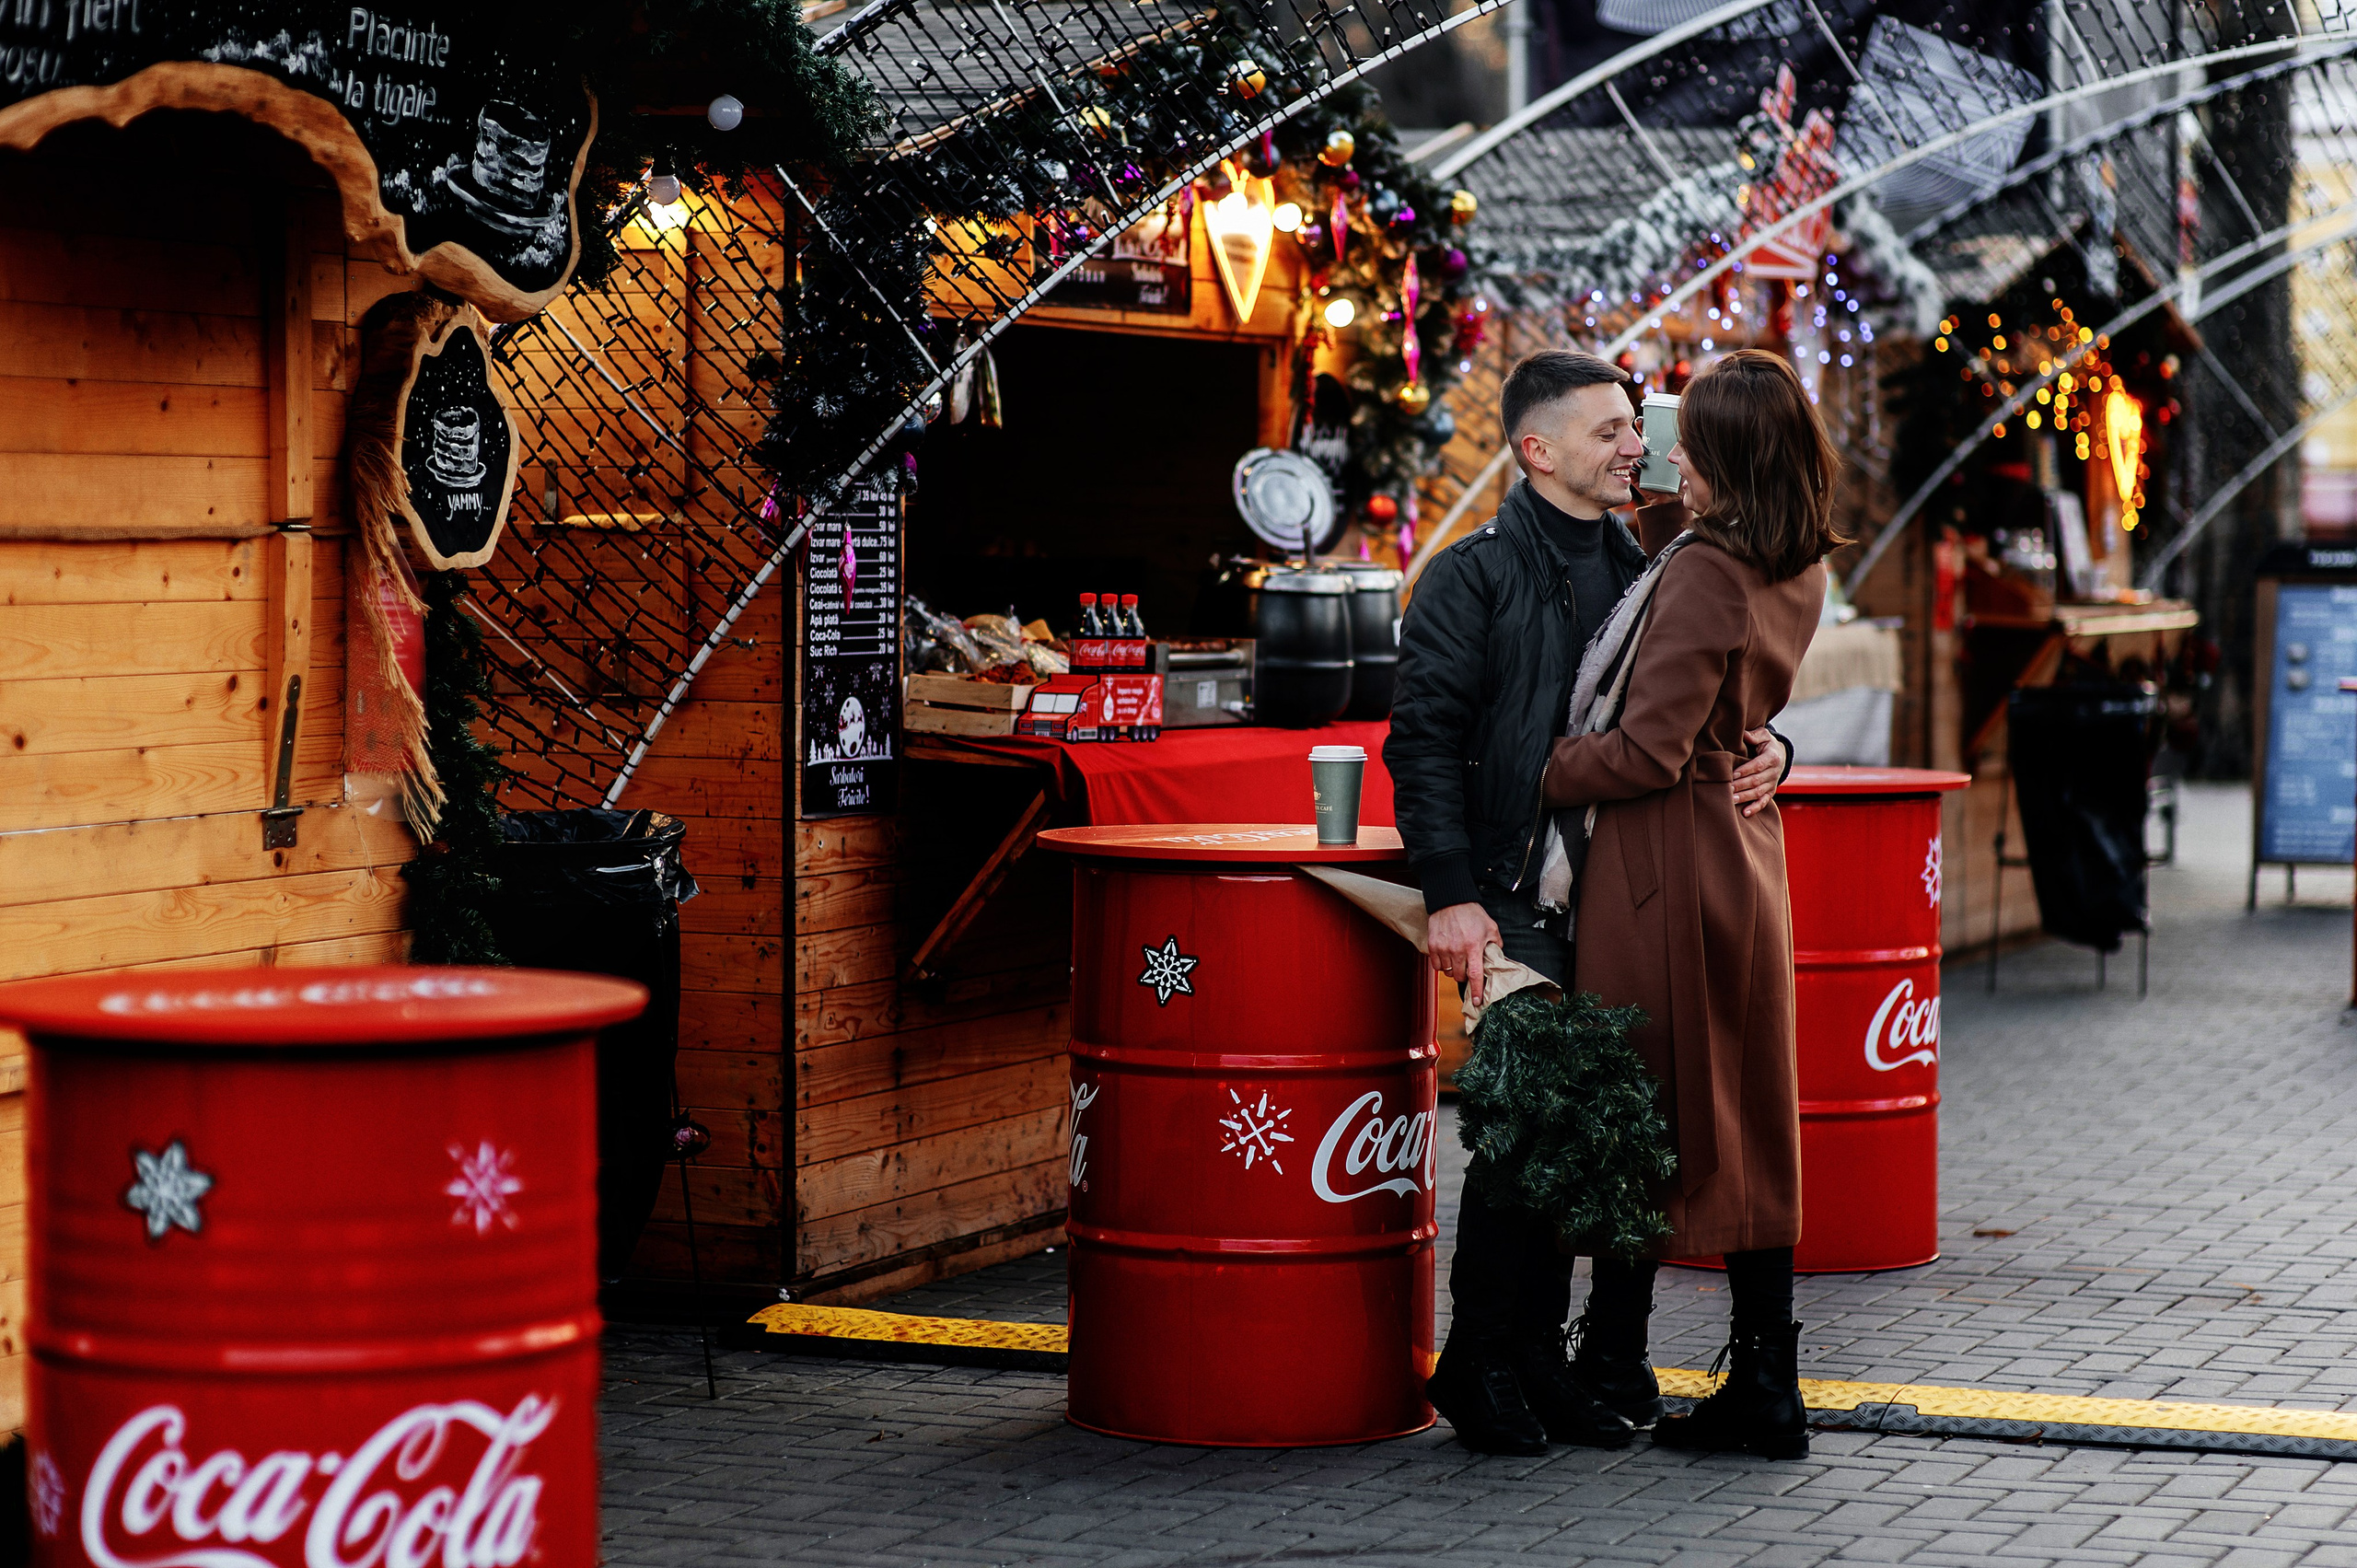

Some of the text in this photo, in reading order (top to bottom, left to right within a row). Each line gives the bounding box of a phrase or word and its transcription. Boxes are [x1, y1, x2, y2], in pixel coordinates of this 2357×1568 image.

[0, 0, 50, 28] in
[344, 70, 365, 109] la
[888, 505, 896, 517] lei
[813, 520, 896, 532] zvar mare 50 lei
[810, 536, 825, 548] Izvar
[826, 538, 841, 548] mare
[888, 536, 896, 548] lei
[810, 552, 825, 563] Izvar
[888, 552, 896, 563] lei
[810, 566, 896, 579] Ciocolată 25 lei
[810, 583, 838, 595] Ciocolată
[810, 614, 822, 628] Apă
[824, 613, 839, 628] plată
[878, 612, 886, 623] 20
[810, 627, 895, 642] Coca-Cola 25 lei
[810, 643, 895, 656] Suc Rich 20 lei
[80, 1392, 559, 1568] Coca-Cola
